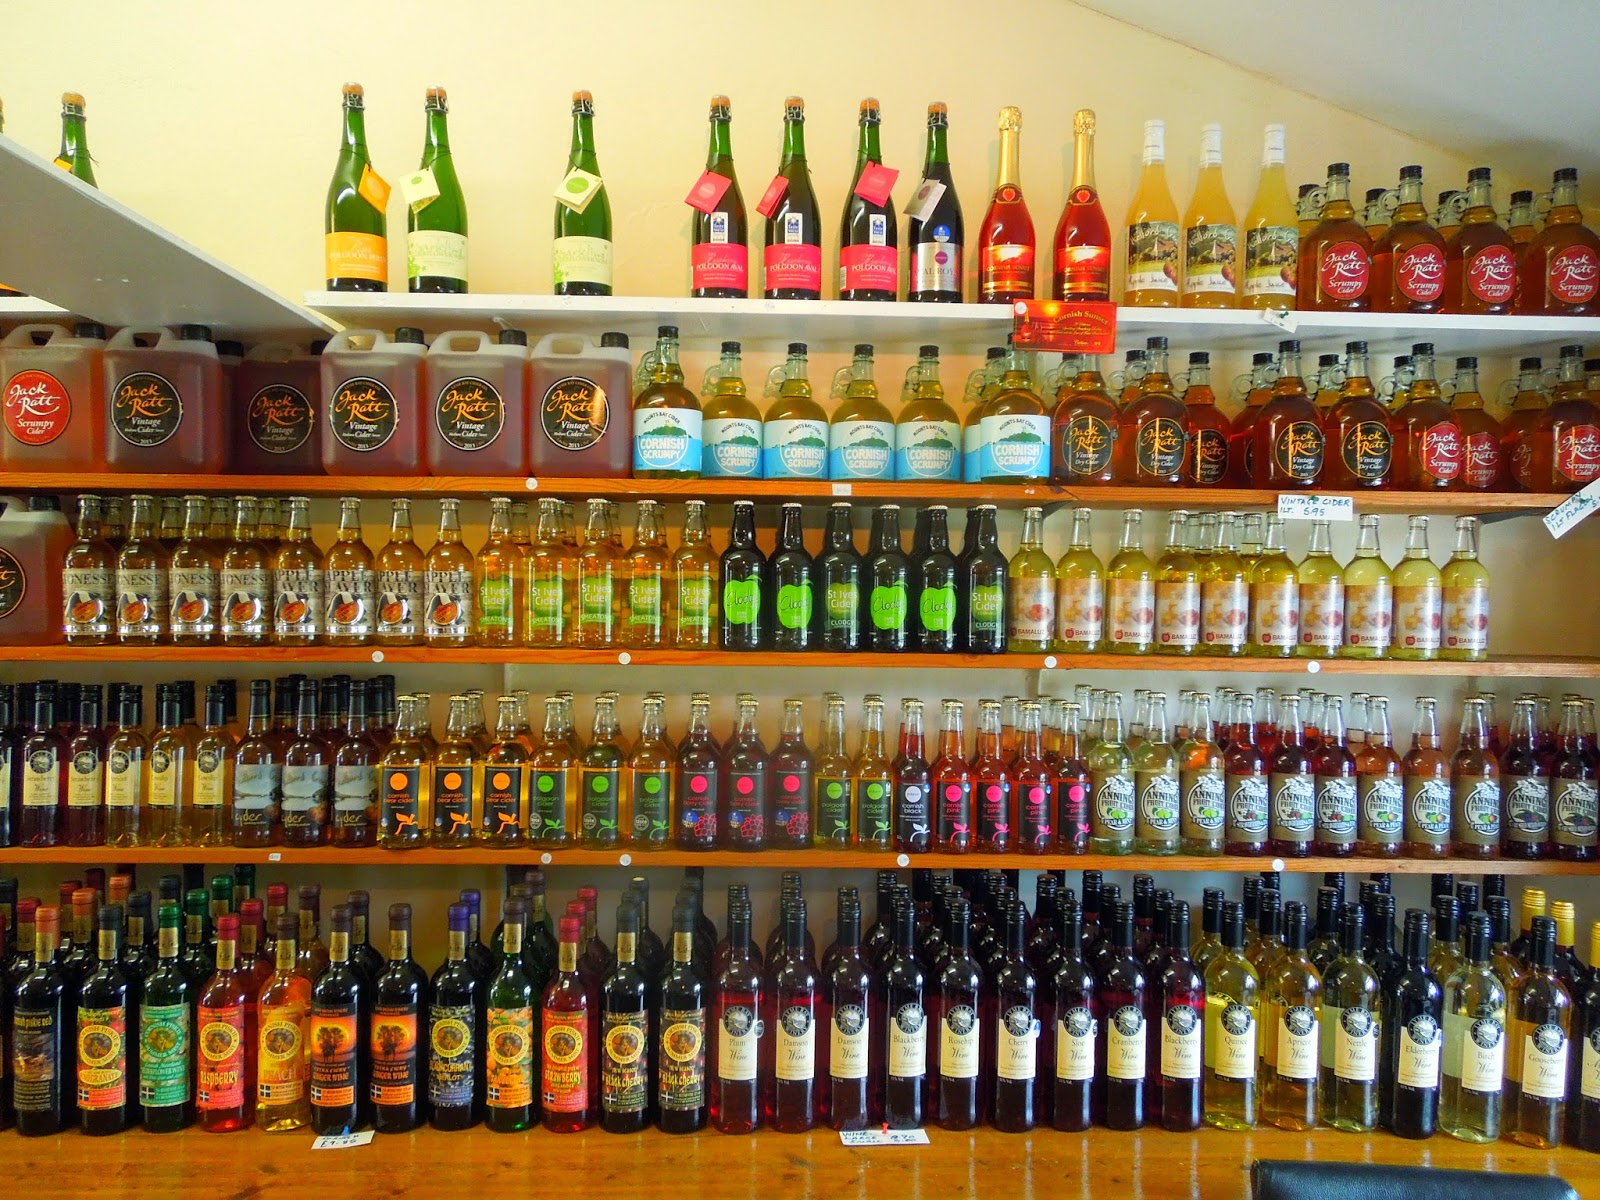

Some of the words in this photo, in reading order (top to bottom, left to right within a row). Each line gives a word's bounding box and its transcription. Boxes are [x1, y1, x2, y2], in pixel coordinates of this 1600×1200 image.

[1321, 250, 1358, 272] Jack
[1399, 252, 1436, 274] Jack
[1550, 253, 1588, 275] Jack
[1335, 263, 1366, 280] Ratt
[1412, 264, 1443, 281] Ratt
[1563, 265, 1596, 282] Ratt
[1328, 280, 1362, 291] Scrumpy
[1406, 281, 1440, 292] Scrumpy
[1558, 282, 1594, 293] Scrumpy
[6, 382, 48, 408] Jack
[116, 384, 160, 408] Jack
[335, 388, 377, 412] Jack
[546, 388, 591, 412] Jack
[16, 396, 61, 418] Ratt
[344, 401, 390, 424] Ratt
[556, 401, 600, 423] Ratt
[17, 418, 54, 430] Scrumpy
[132, 417, 162, 428] Vintage
[350, 422, 378, 432] Vintage
[561, 421, 590, 431] Vintage
[26, 427, 46, 436] Cider
[354, 430, 372, 438] Cider
[640, 438, 685, 450] CORNISH
[1559, 434, 1595, 454] Jack
[642, 450, 681, 460] SCRUMPY
[717, 446, 758, 458] CORNISH
[845, 448, 887, 460] CORNISH
[994, 444, 1040, 456] CORNISH
[720, 458, 756, 468] SCRUMPY
[849, 460, 884, 469] SCRUMPY
[998, 456, 1038, 466] SCRUMPY
[1564, 461, 1600, 472] Scrumpy
[1322, 498, 1350, 506] CIDER
[480, 586, 488, 596] St
[490, 586, 510, 595] Ives
[582, 584, 590, 592] St
[594, 584, 612, 592] Ives
[584, 594, 608, 602] Cider
[828, 590, 836, 599] St
[840, 590, 858, 598] Ives
[482, 596, 506, 605] Cider
[831, 599, 854, 608] Cider
[1346, 1038, 1368, 1047] Nettle
